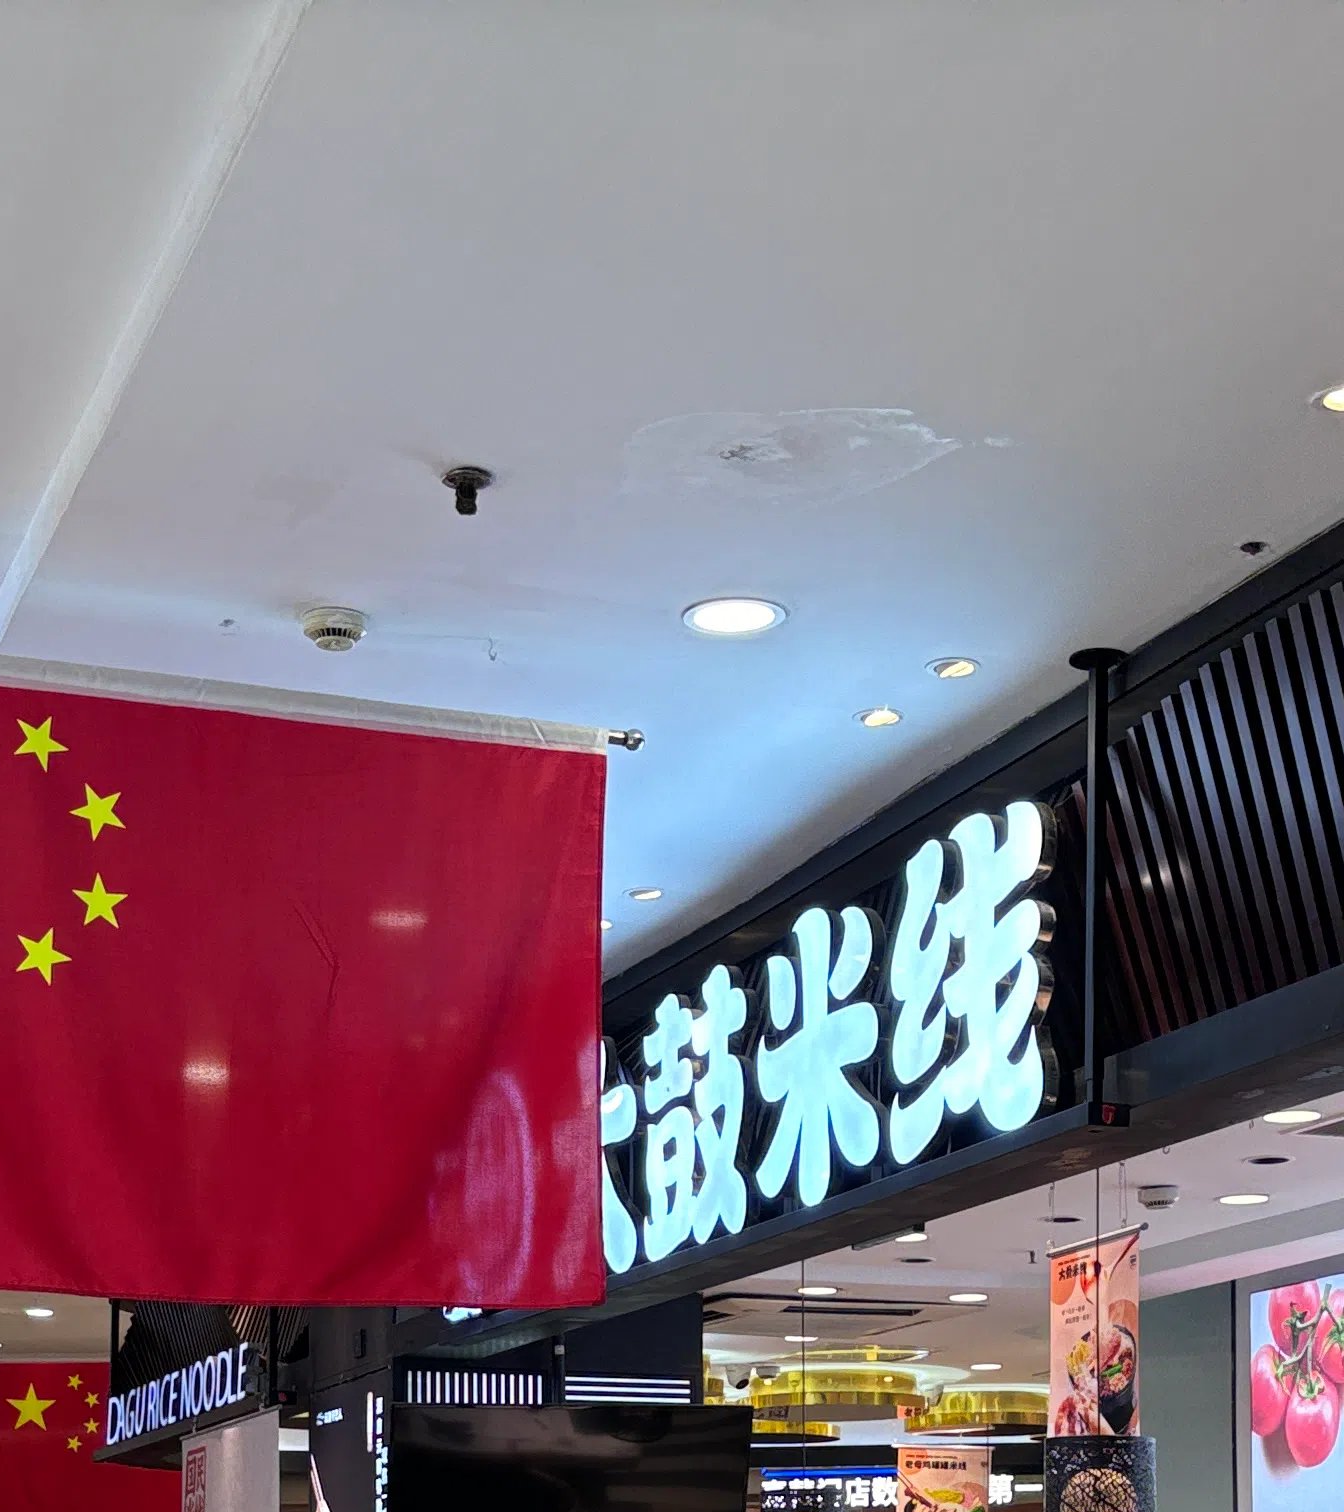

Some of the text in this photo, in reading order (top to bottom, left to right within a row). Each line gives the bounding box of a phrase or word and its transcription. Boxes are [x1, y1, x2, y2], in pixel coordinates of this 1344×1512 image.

[106, 1341, 249, 1446] DAGU RICE NOODLE
[988, 1473, 1044, 1505] 第一
